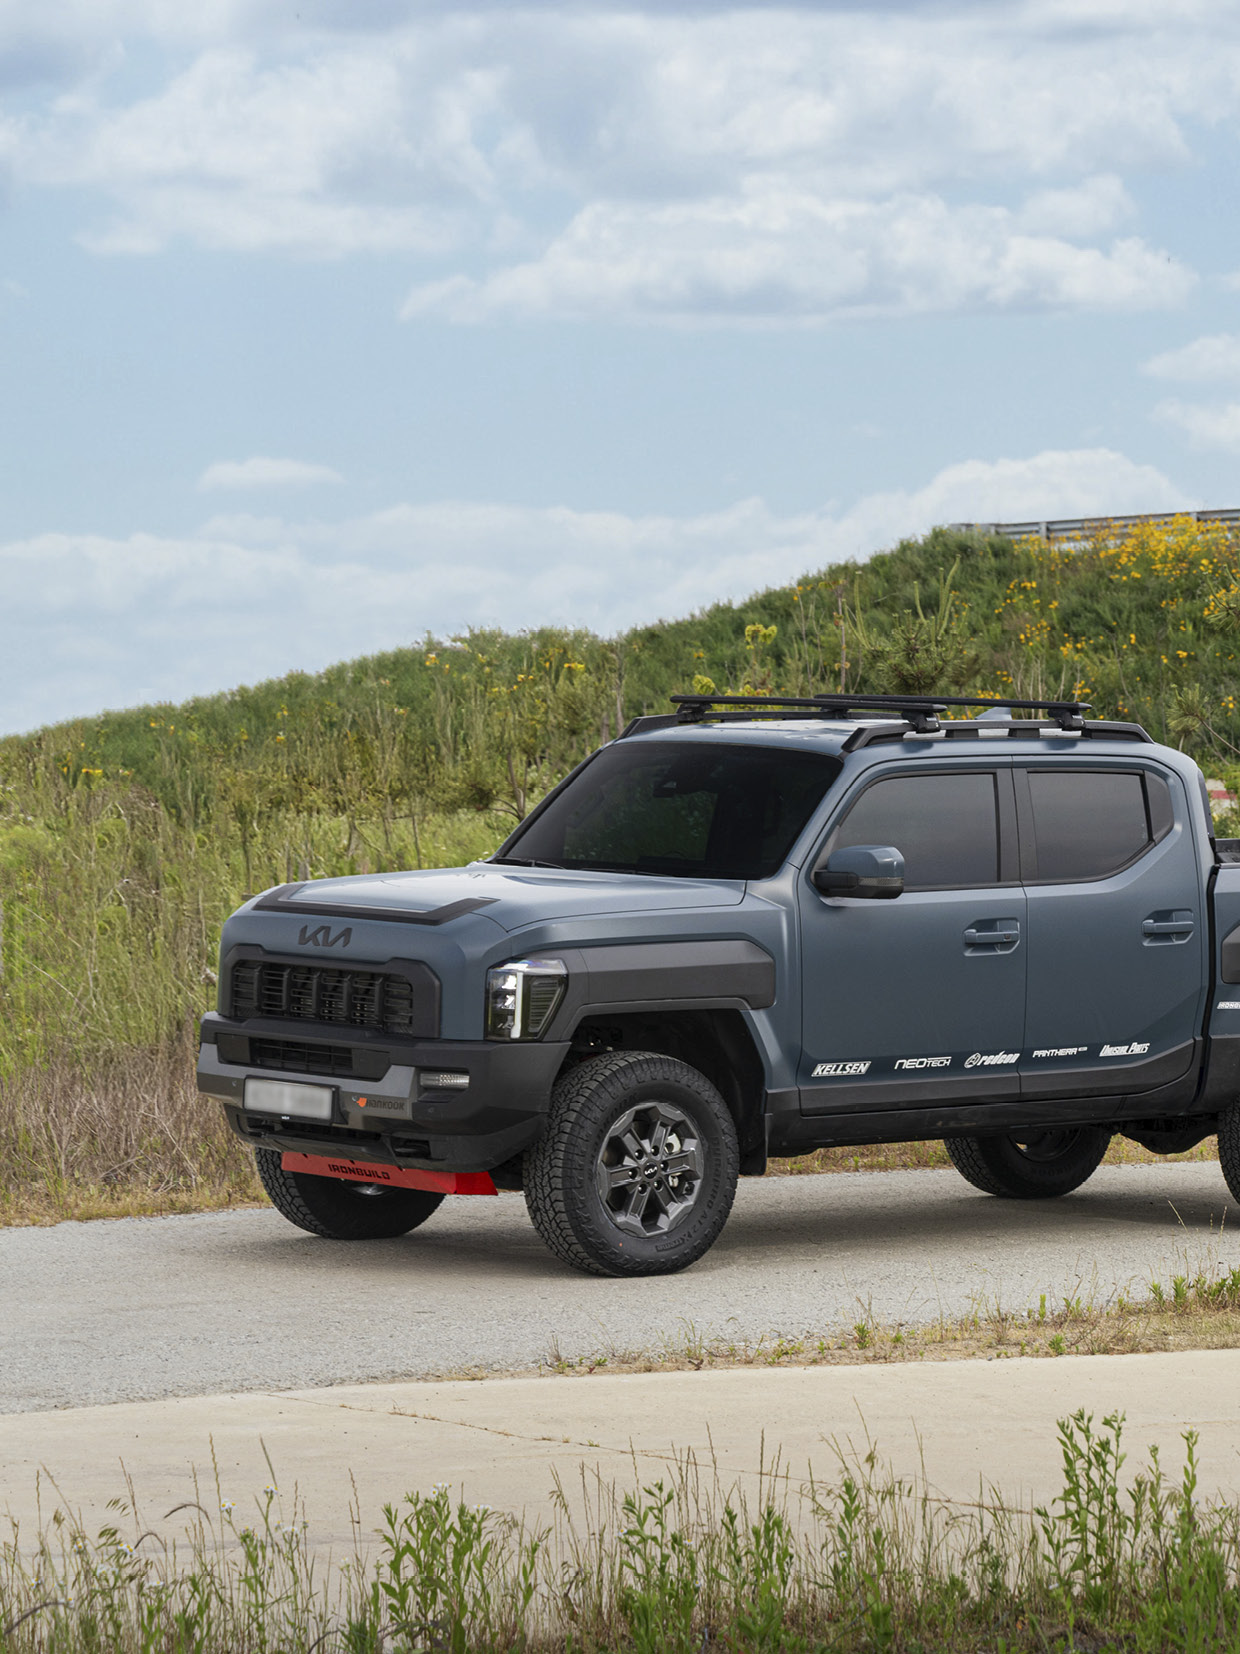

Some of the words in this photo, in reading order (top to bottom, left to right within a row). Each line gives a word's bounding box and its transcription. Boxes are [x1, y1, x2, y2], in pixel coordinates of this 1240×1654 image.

[298, 924, 353, 948] KIA
[1032, 1047, 1078, 1058] PANTHERA
[814, 1063, 869, 1075] KELLSEN
[894, 1056, 952, 1070] NEOTECH
